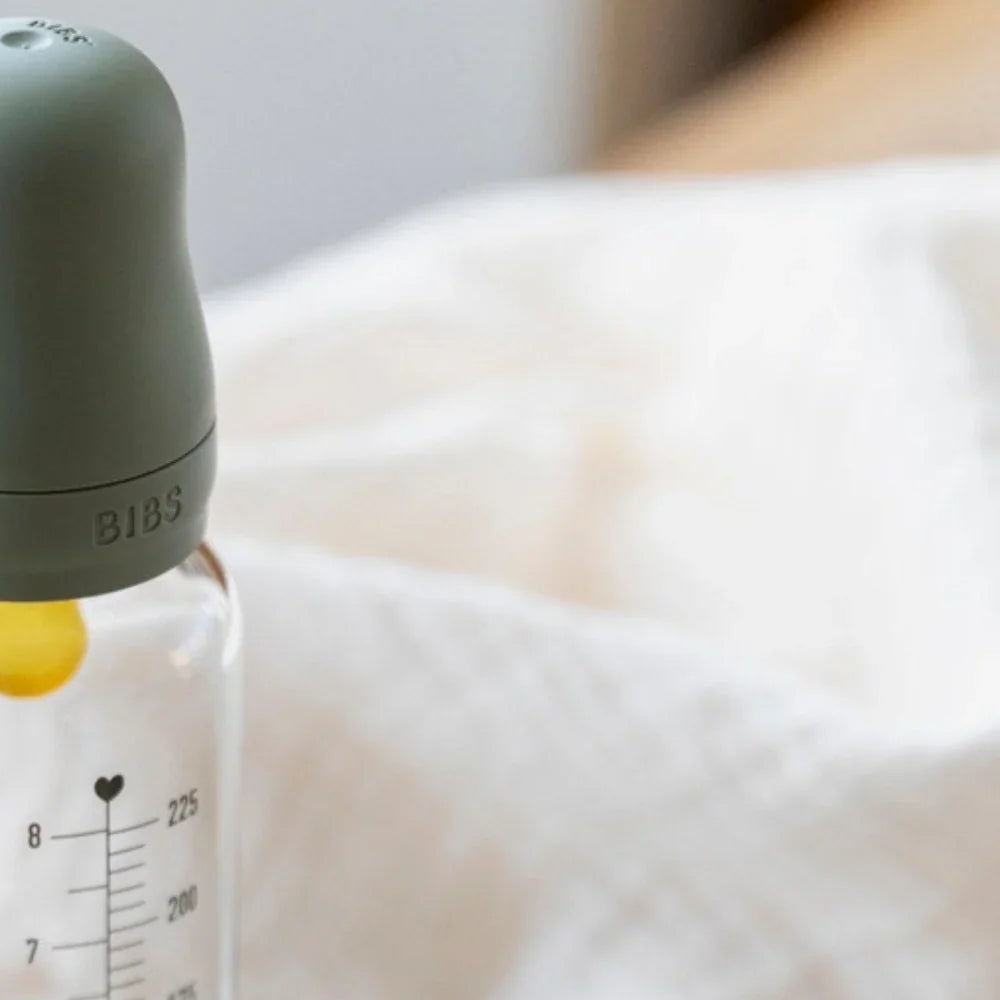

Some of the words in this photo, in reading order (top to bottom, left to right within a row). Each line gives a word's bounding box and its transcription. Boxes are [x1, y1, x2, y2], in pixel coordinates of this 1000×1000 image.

[94, 485, 182, 546] BIBS
[167, 788, 198, 828] 225
[26, 822, 42, 849] 8
[167, 885, 198, 923] 200
[25, 937, 40, 965] 7
